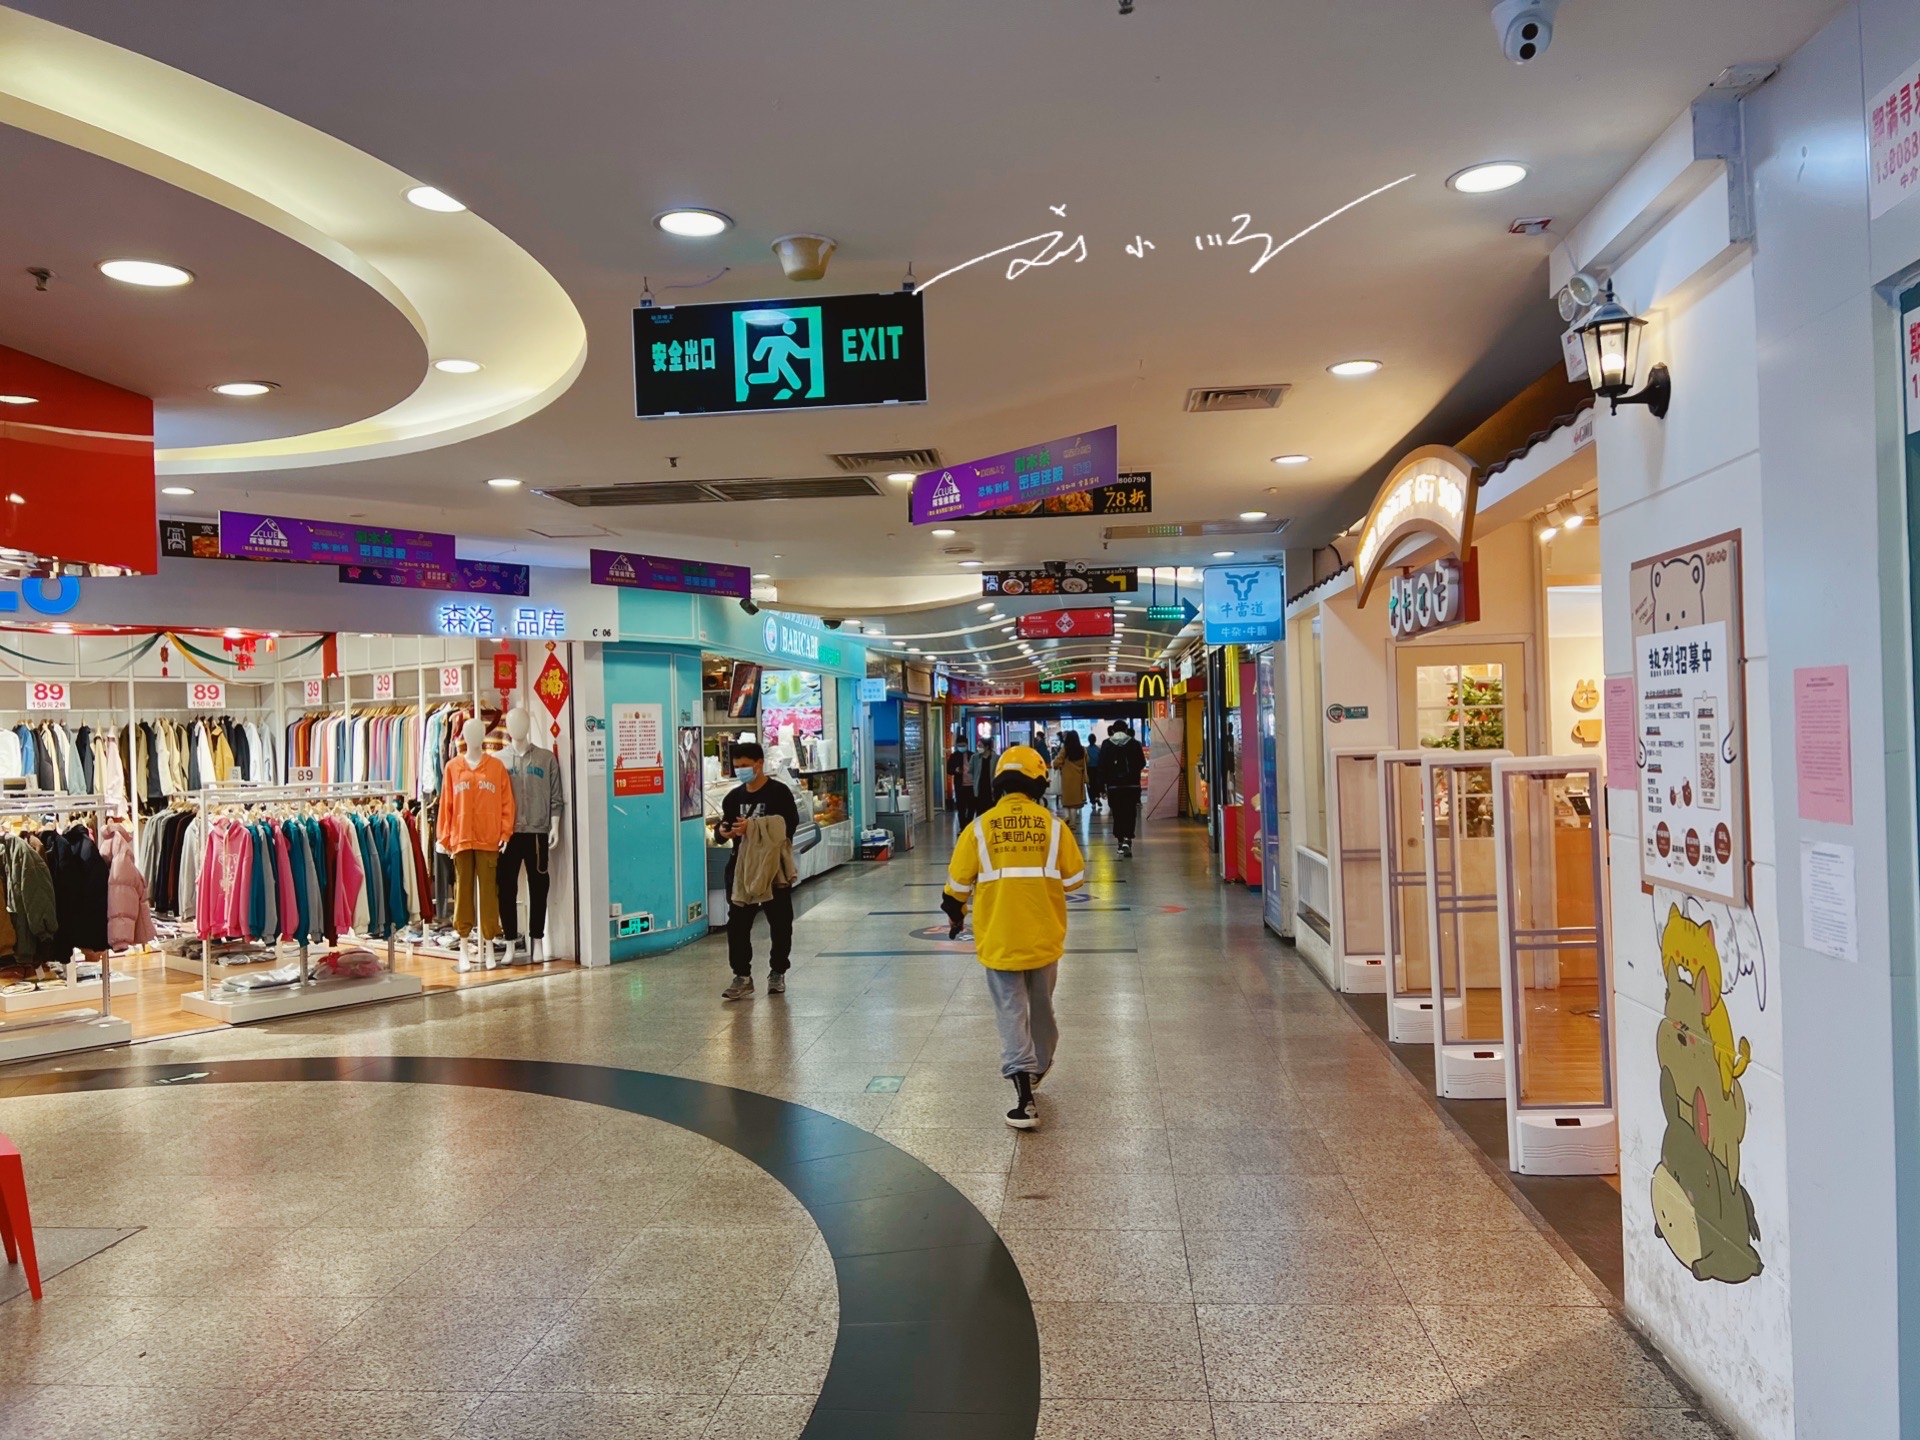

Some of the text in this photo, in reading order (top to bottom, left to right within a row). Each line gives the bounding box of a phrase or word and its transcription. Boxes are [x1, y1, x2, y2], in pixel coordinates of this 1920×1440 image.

[842, 326, 903, 362] EXIT
[651, 337, 716, 373] 安全出口
[1018, 465, 1064, 491] 密室逃脱
[257, 529, 279, 539] CLUE
[602, 628, 612, 637] 06
[376, 674, 391, 692] 39
[443, 667, 458, 686] 39
[34, 682, 64, 701] 89
[194, 684, 220, 700] 89
[307, 681, 320, 697] 39
[297, 769, 314, 782] 89
[990, 814, 1046, 830] 美团优选
